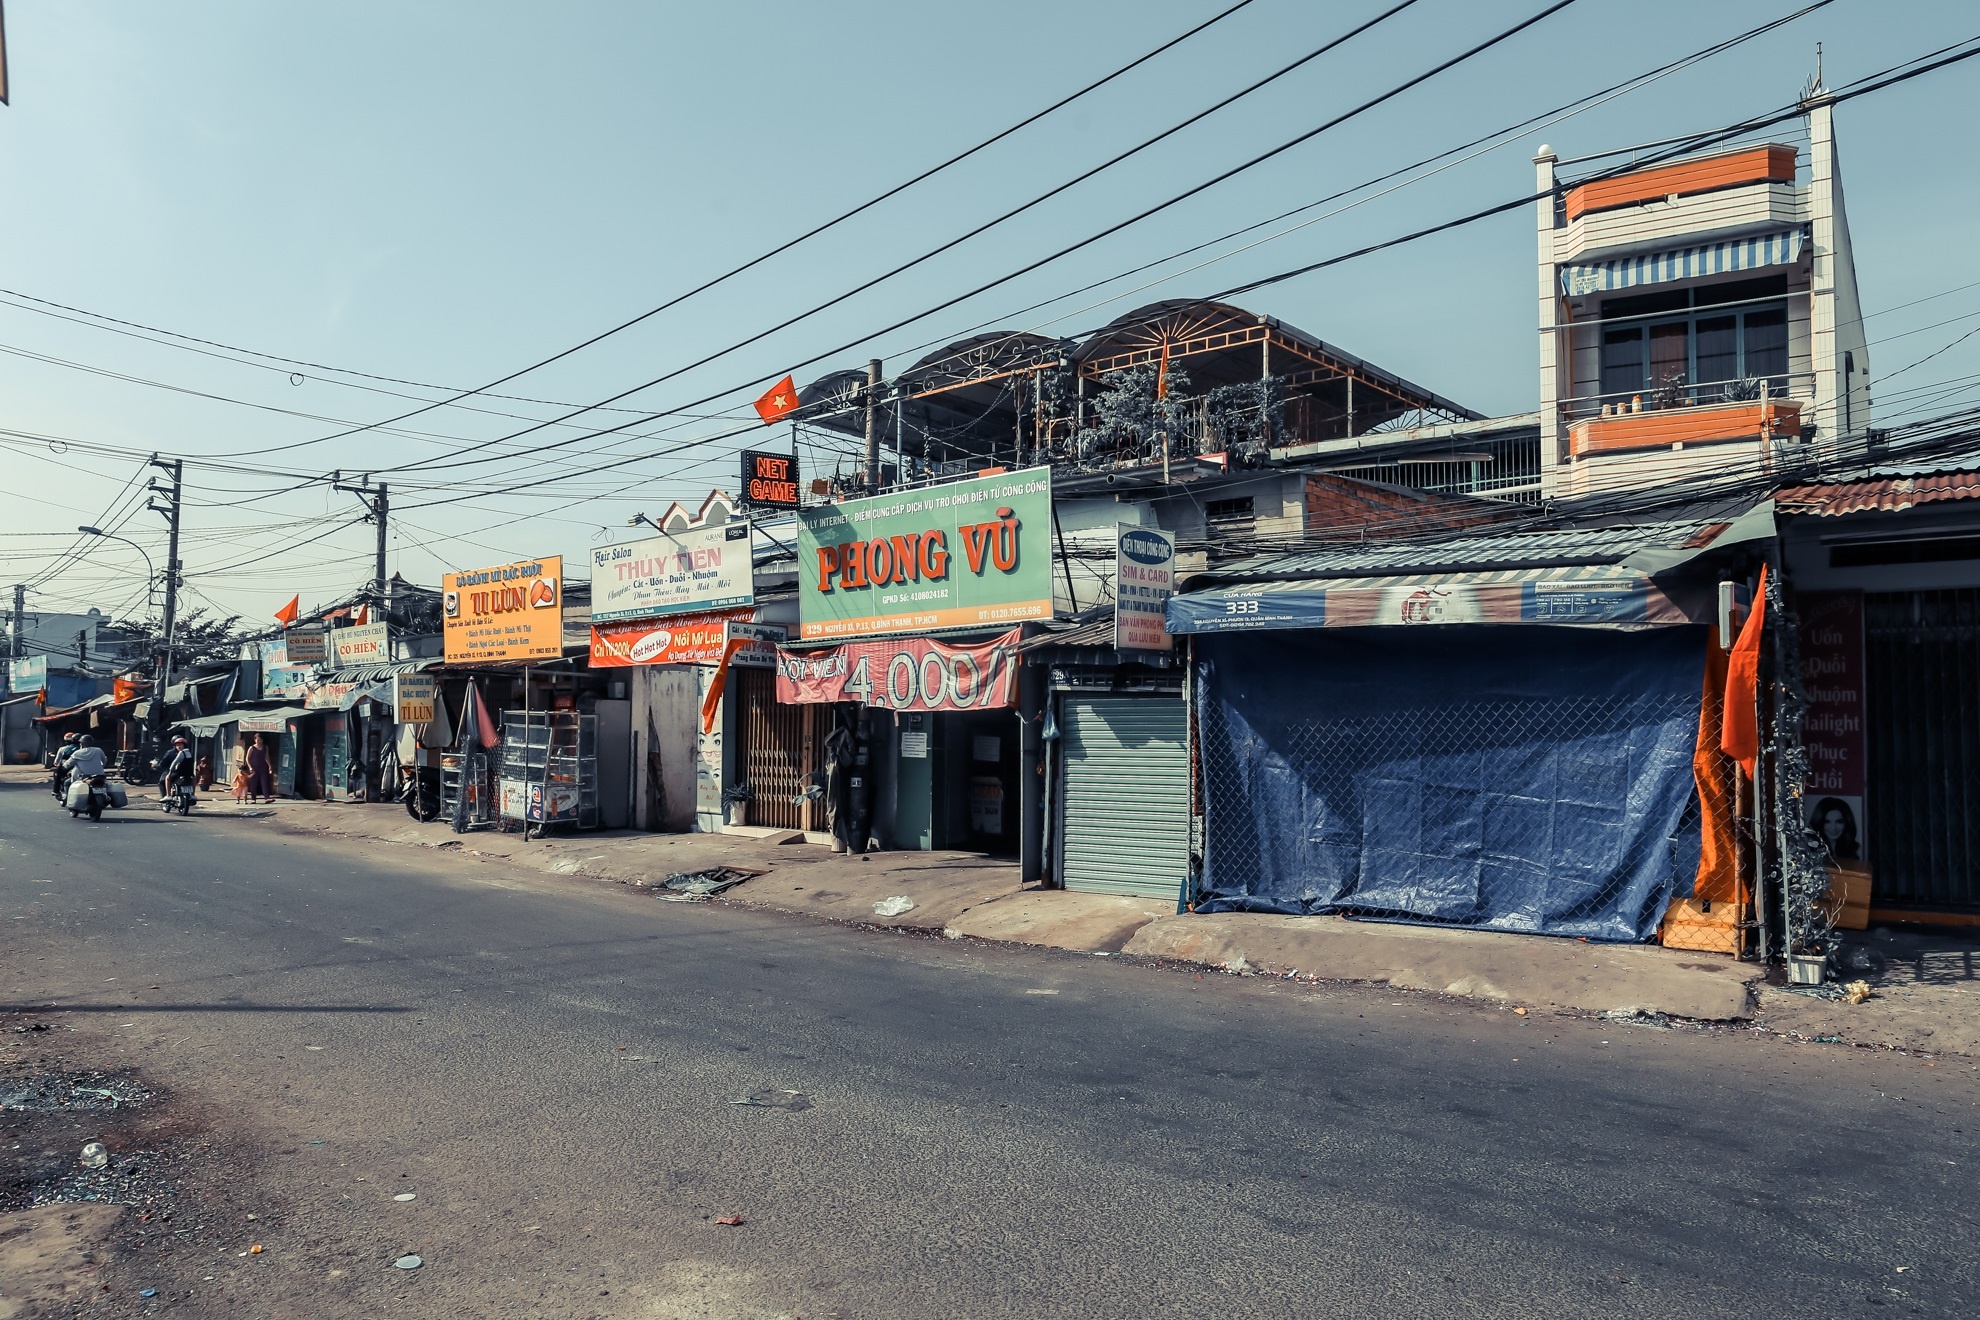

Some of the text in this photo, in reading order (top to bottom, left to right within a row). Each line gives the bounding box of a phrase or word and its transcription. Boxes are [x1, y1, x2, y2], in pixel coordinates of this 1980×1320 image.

[757, 457, 788, 479] NET
[751, 479, 797, 502] GAME
[799, 480, 1047, 533] ĐẠI LÝ INTERNET ĐIỂM CUNG CẤP DỊCH VỤ TRÒ CHƠI ĐIỆN TỬ CÔNG CỘNG
[816, 506, 1020, 592] PHONG VŨ
[1123, 535, 1133, 555] ĐIỆN
[1134, 539, 1147, 558] THOẠI
[1148, 539, 1158, 557] CÔNG
[594, 548, 632, 567] Hair Salon
[650, 578, 663, 587] Uốn
[693, 570, 718, 581] Nhuộm
[1123, 565, 1169, 584] SIM & CARD
[491, 582, 526, 614] LÙN
[883, 593, 899, 605] GPKD
[911, 589, 949, 602] 4108024182
[1226, 601, 1259, 615] 333
[807, 624, 823, 635] 329
[915, 615, 938, 626] TP.HCM
[1812, 624, 1843, 646] Uốn
[354, 637, 378, 654] HIỀN
[633, 638, 668, 659] Hot Hot Hot
[674, 630, 690, 646] Nối
[1809, 653, 1847, 675] Duỗi
[409, 677, 424, 686] BÁNH
[414, 702, 433, 720] LÙN
[1809, 743, 1848, 765] Phục
[1815, 768, 1843, 790] Hồi
